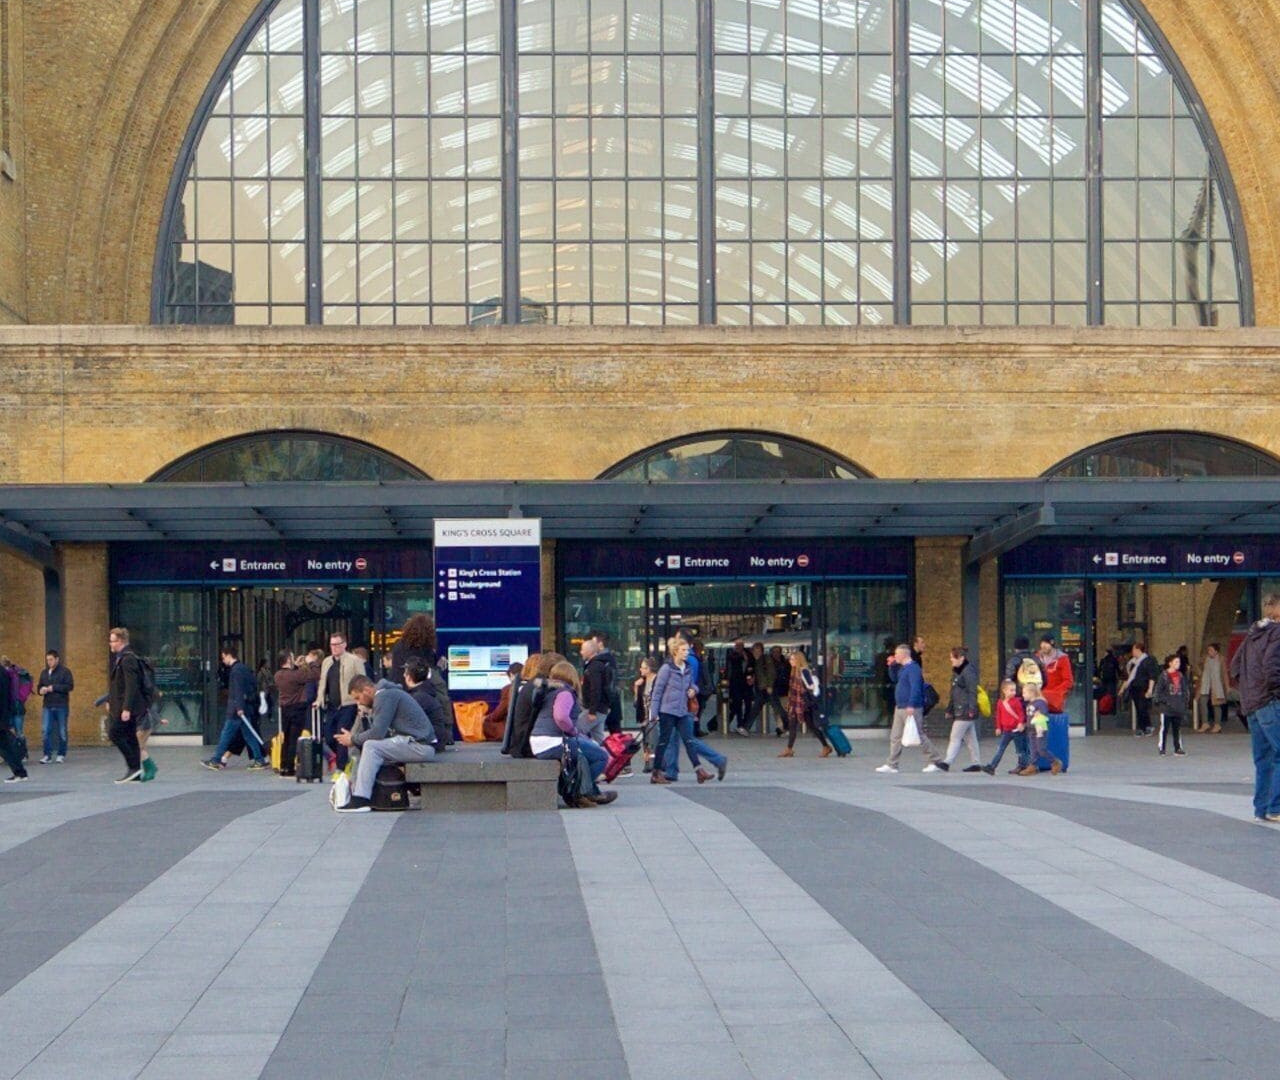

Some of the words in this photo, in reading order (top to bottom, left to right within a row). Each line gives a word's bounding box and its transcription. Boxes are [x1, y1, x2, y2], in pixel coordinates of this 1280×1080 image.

[442, 529, 469, 537] KING'S
[470, 529, 497, 537] CROSS
[500, 528, 532, 537] SQUARE
[685, 557, 729, 567] Entrance
[750, 556, 765, 566] No
[767, 557, 794, 568] entry
[1122, 554, 1167, 564] Entrance
[1187, 554, 1202, 564] No
[1204, 554, 1230, 566] entry
[240, 560, 286, 570] Entrance
[307, 560, 322, 570] No
[324, 560, 352, 571] entry
[459, 569, 477, 577] King's
[459, 580, 501, 589] Underground
[384, 606, 393, 619] 3
[573, 604, 583, 618] 7
